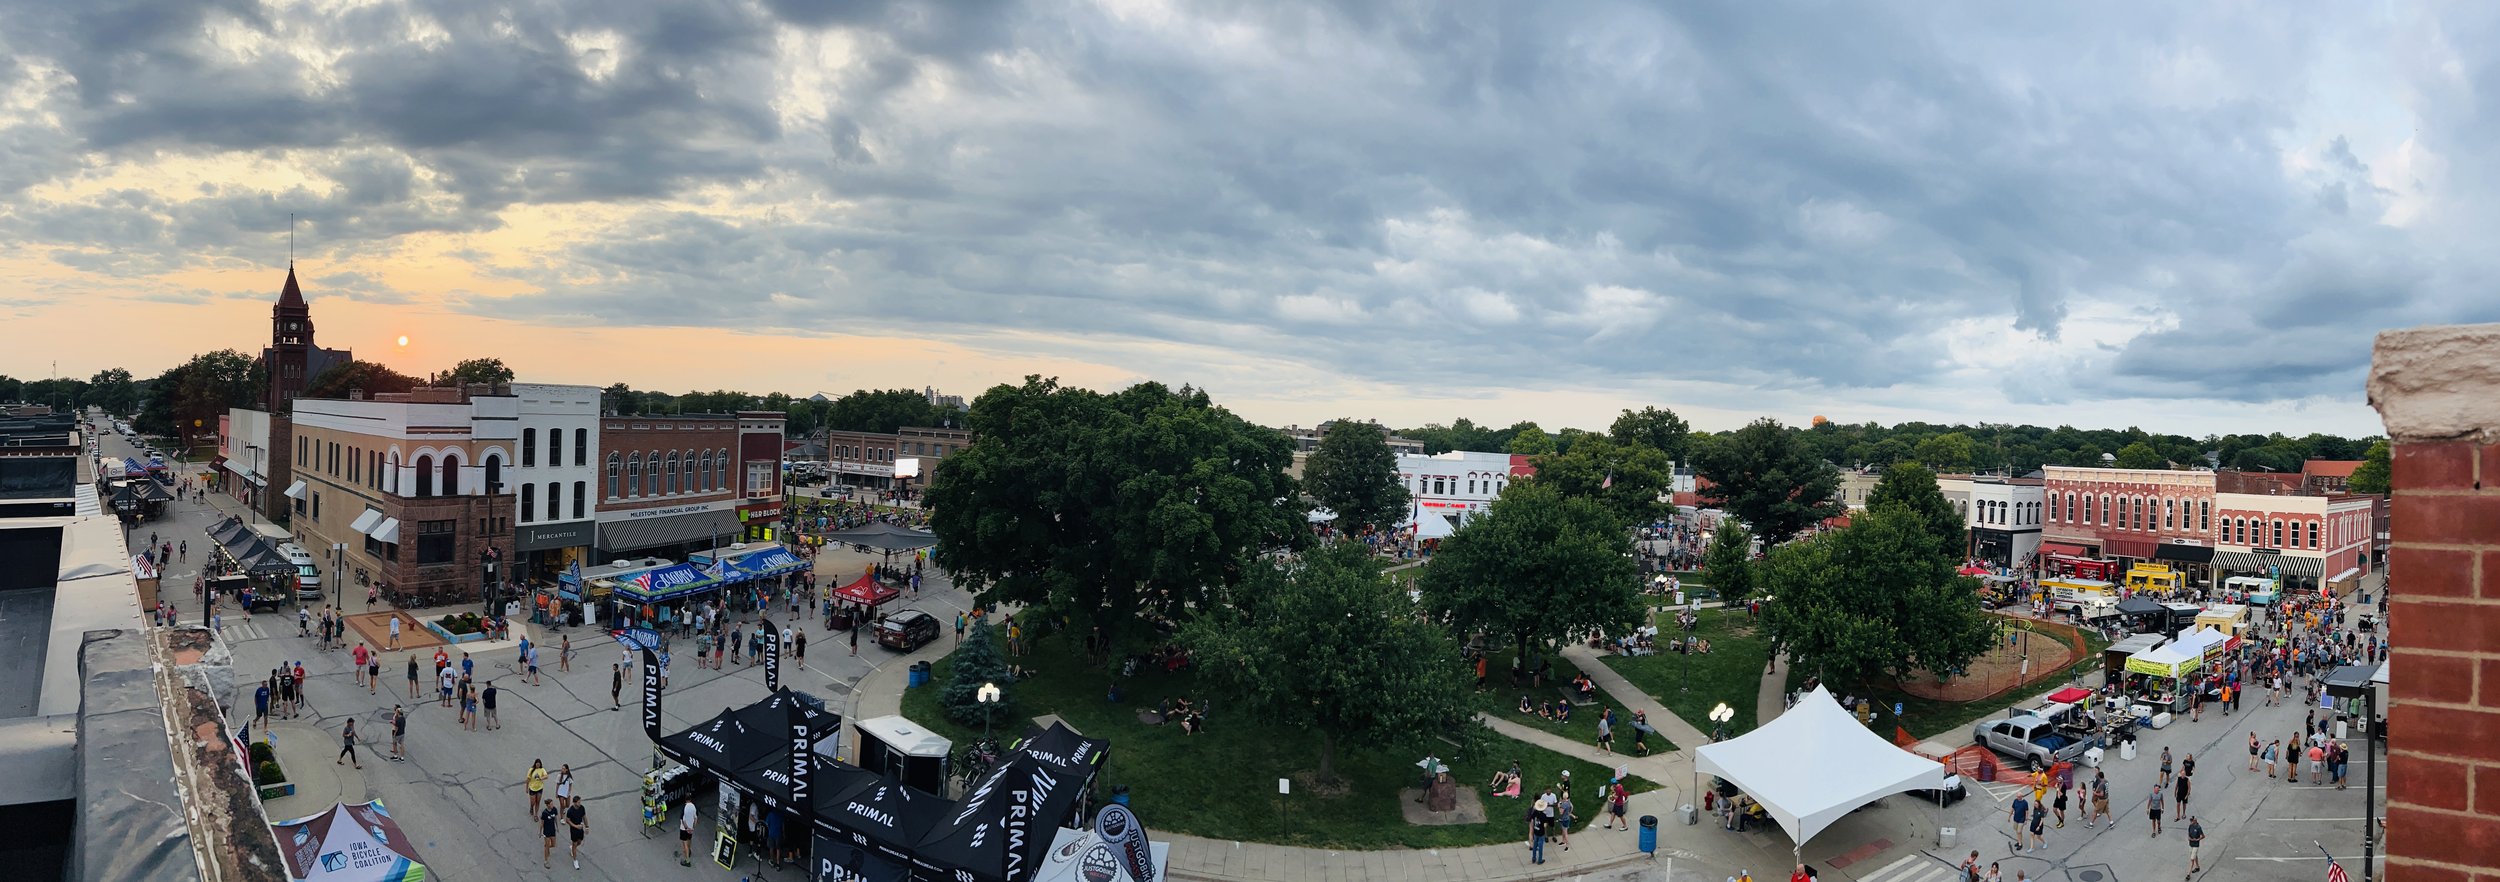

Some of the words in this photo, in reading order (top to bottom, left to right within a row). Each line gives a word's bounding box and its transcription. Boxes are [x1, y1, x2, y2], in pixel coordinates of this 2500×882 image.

[630, 510, 658, 518] MILESTONE
[658, 507, 684, 515] FINANCIAL
[684, 505, 700, 513] GROUP
[750, 510, 763, 519] H&R
[763, 508, 781, 517] BLOCK
[530, 530, 535, 544] J
[537, 531, 577, 540] MERCANTILE
[766, 633, 776, 688] PRIMAL
[645, 664, 657, 729] PRIMAL
[688, 731, 725, 754] PRIMAL
[1071, 740, 1092, 765] PRIMAL
[793, 725, 808, 802] PRIMAL
[762, 769, 790, 786] PRIM
[846, 801, 894, 828] PRIMAL
[1007, 790, 1028, 881] PRIMAL
[349, 841, 368, 851] IOWA
[351, 847, 381, 861] BICYCLE
[354, 854, 392, 869] COALITION
[1083, 865, 1115, 876] JUSTGOBIKE
